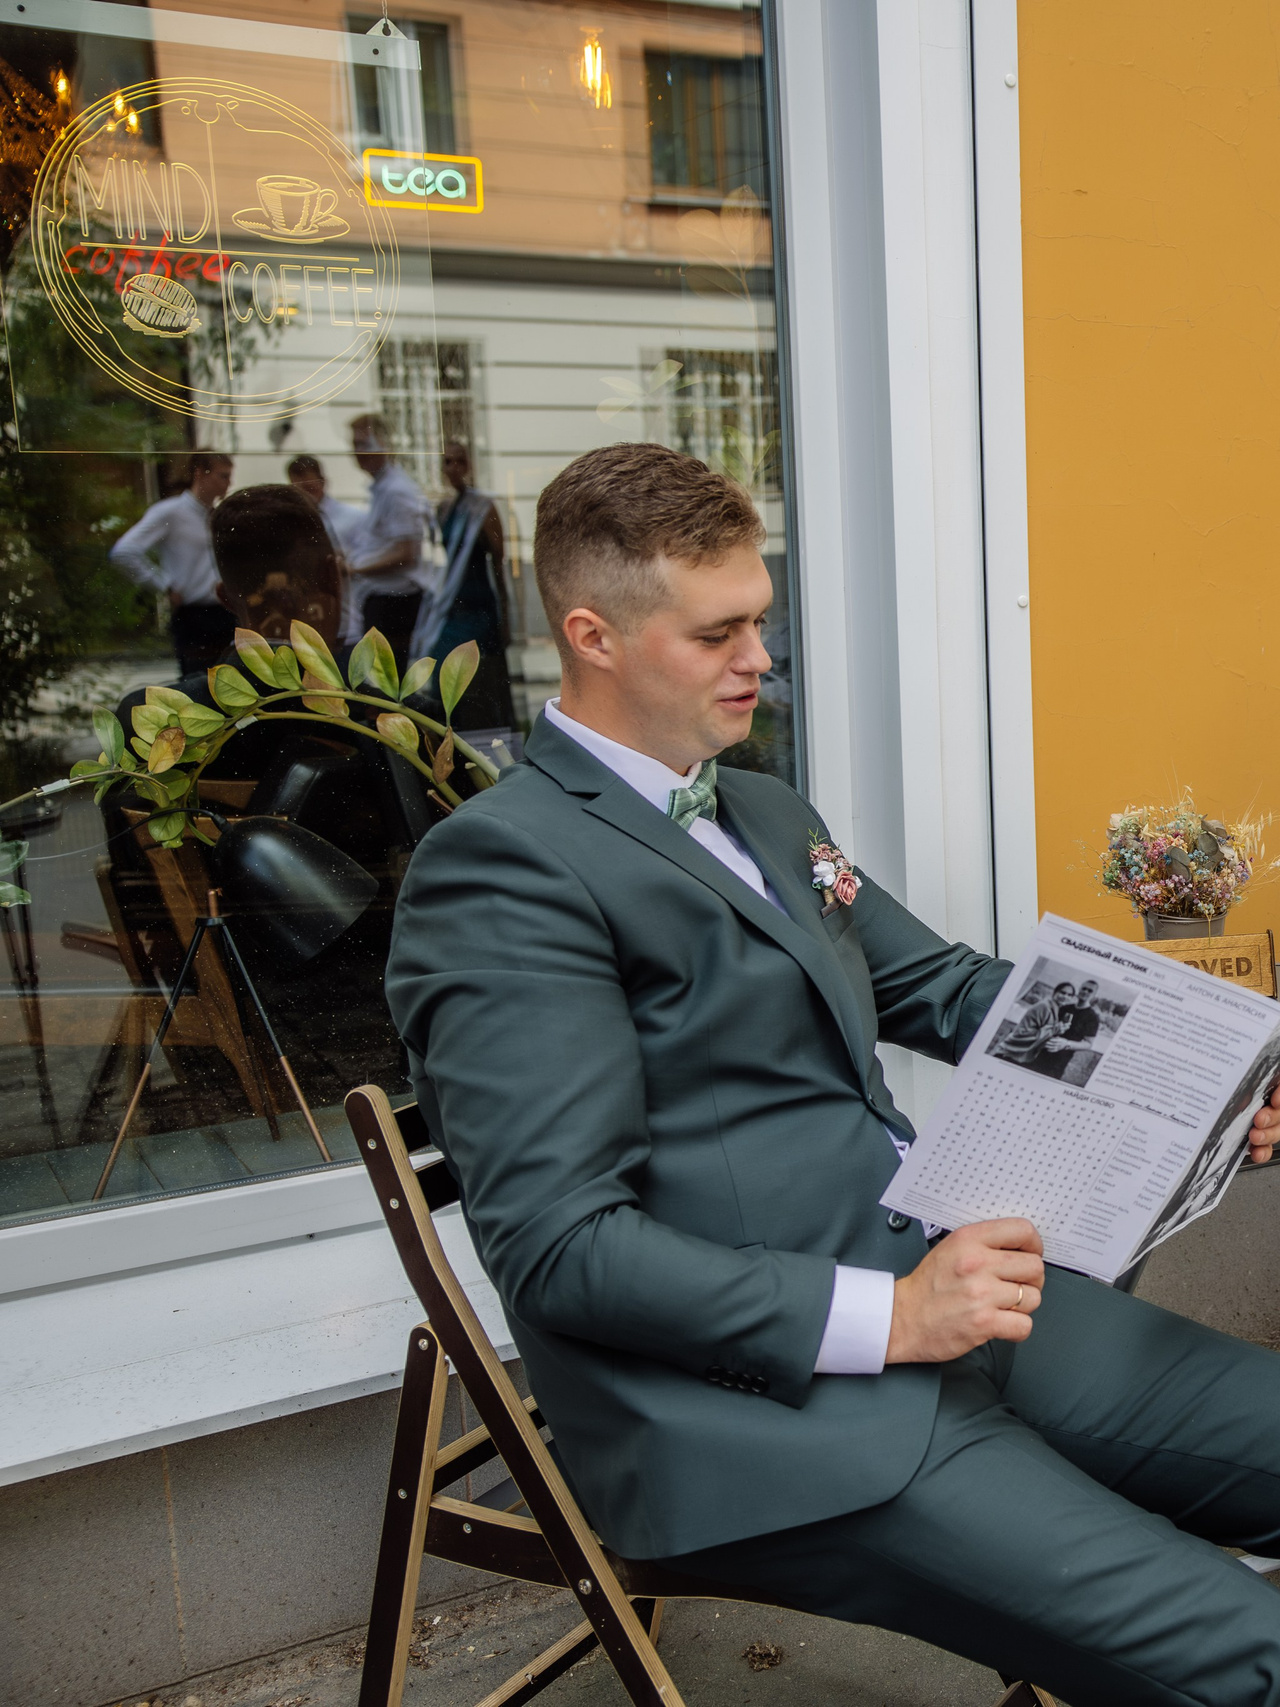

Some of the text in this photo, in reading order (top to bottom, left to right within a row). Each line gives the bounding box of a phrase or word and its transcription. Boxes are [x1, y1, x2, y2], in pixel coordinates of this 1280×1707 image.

[74, 154, 212, 244] MIND
[381, 163, 467, 199] tea
[1061, 935, 1147, 973] СВАДЕБНЫЙ ВЕСТНИК
[1187, 984, 1213, 997] АНТОН
[1222, 998, 1266, 1018] АНАСТАСИЯ
[1063, 1089, 1114, 1108] НАЙДИ СЛОВО
